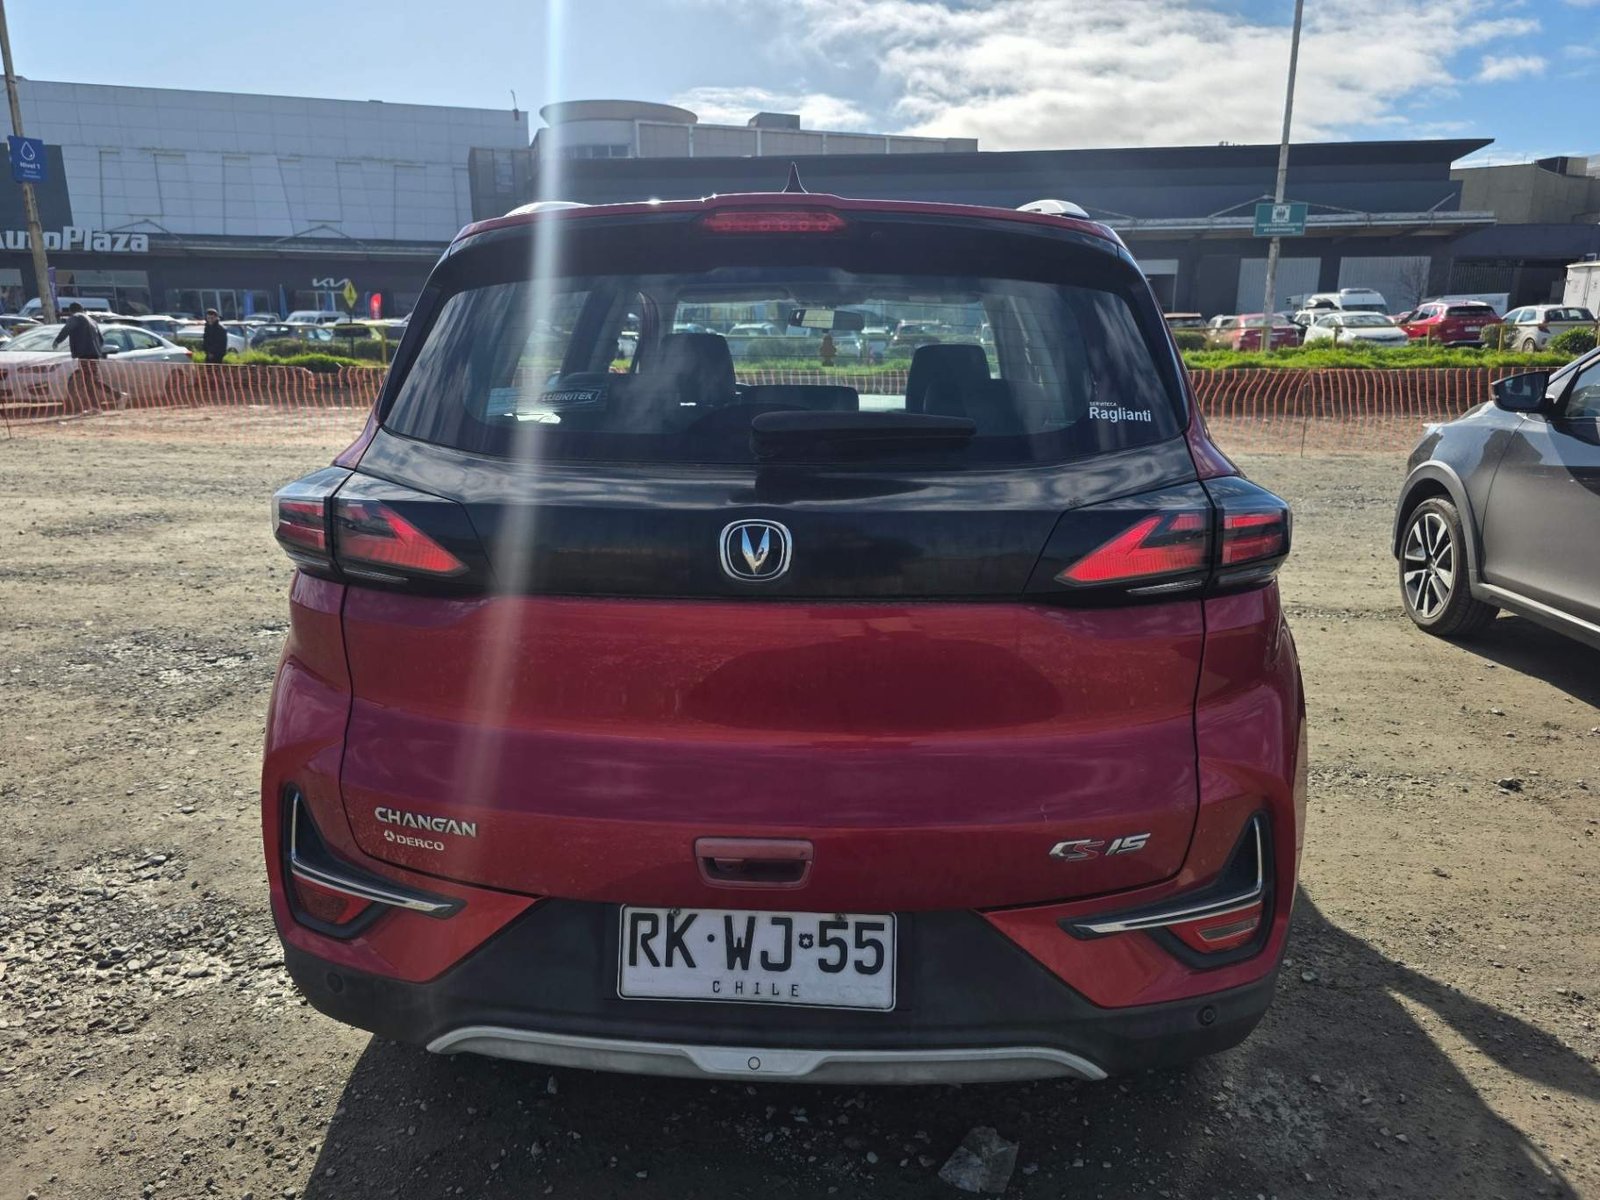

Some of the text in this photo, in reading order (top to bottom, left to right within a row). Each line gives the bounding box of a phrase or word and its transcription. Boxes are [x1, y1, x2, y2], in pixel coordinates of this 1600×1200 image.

[0, 226, 149, 252] uoPlaza
[1089, 406, 1152, 423] Raglianti
[374, 806, 477, 838] CHANGAN
[396, 834, 445, 851] DERCO
[712, 980, 799, 997] CHILE
